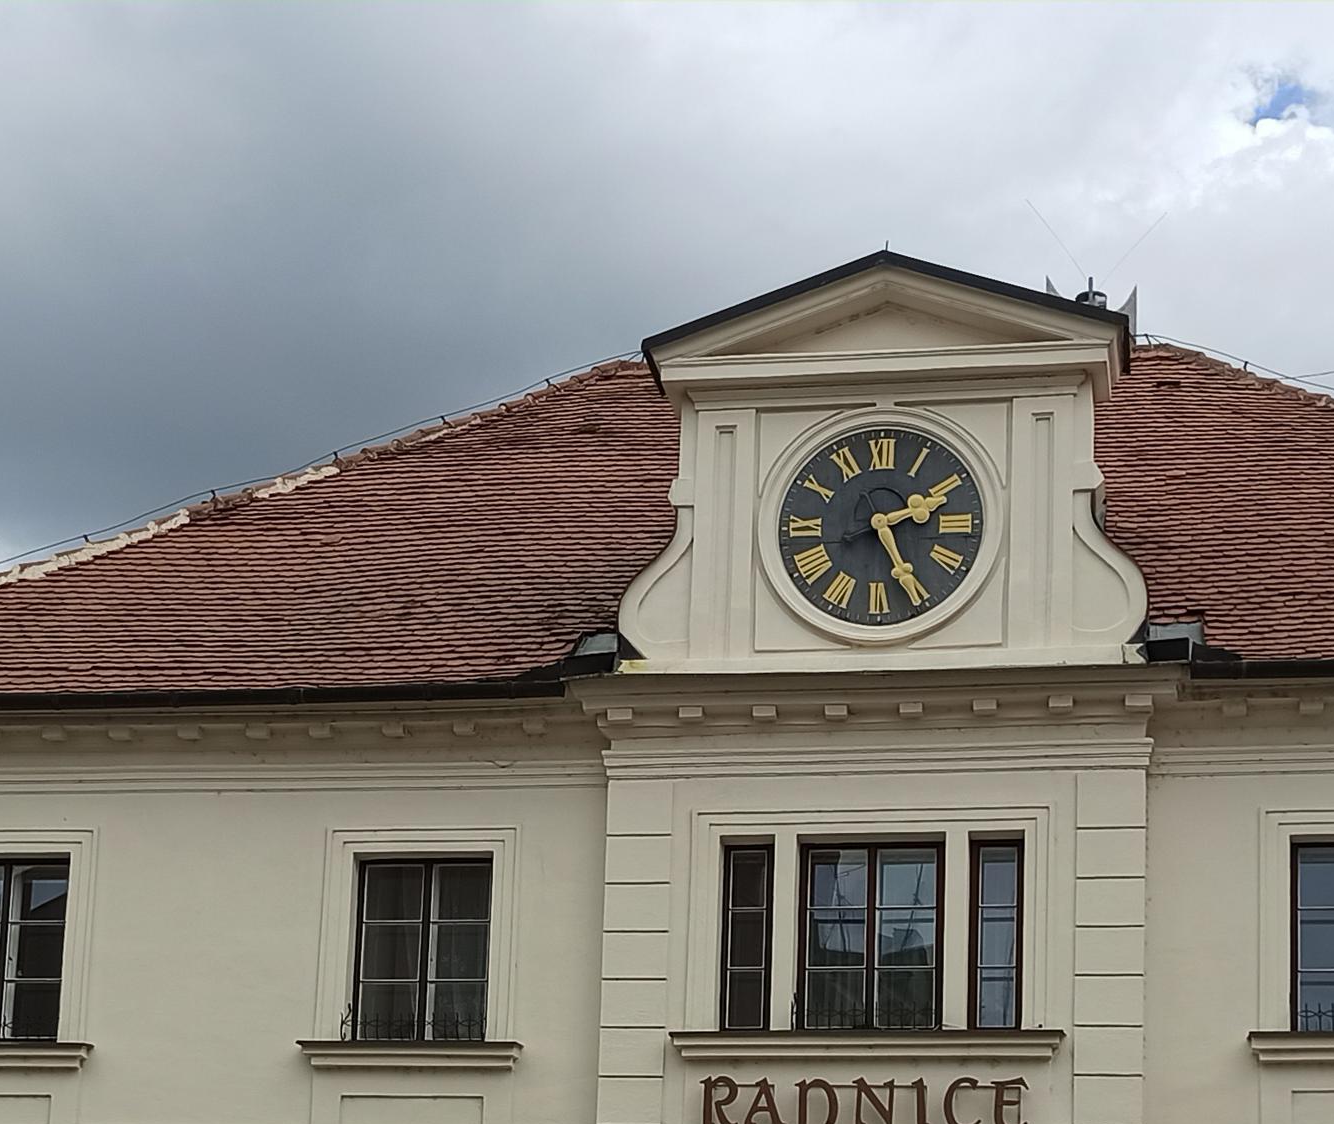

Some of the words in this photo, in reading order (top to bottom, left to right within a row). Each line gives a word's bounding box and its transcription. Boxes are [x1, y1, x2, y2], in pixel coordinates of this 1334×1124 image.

[829, 446, 862, 483] XI
[868, 438, 897, 471] XII
[907, 447, 931, 478] I
[803, 474, 835, 504] X
[928, 473, 963, 497] II
[789, 515, 823, 538] IX
[938, 513, 972, 534] III
[793, 543, 833, 586] VIII
[929, 543, 964, 575] IV
[822, 570, 857, 609] VII
[868, 581, 890, 615] VI
